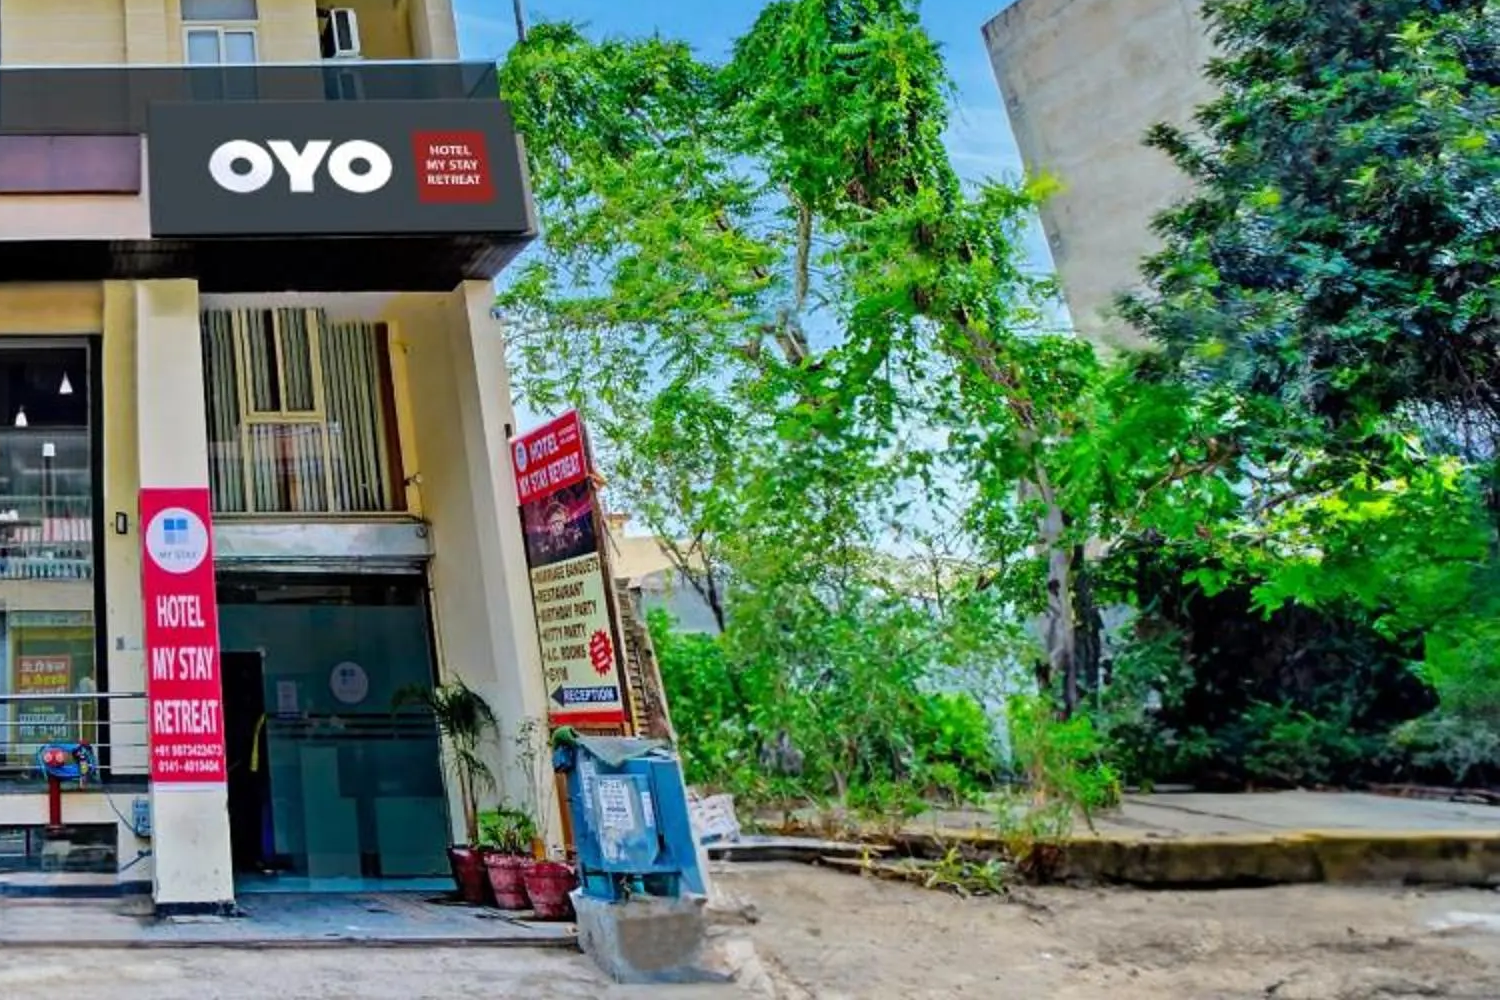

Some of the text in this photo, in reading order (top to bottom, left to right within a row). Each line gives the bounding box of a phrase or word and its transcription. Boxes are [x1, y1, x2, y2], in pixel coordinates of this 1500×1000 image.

[429, 144, 472, 156] HOTEL
[208, 139, 392, 193] OYO
[426, 160, 478, 171] MY STAY
[427, 174, 481, 185] RETREAT
[529, 432, 559, 463] HOTEL
[547, 451, 581, 485] RETREAT
[156, 595, 205, 628] HOTEL
[573, 599, 597, 617] PARTY
[564, 621, 587, 638] PARTY
[153, 647, 213, 680] MY STAY
[563, 687, 615, 704] RECEPTION
[153, 700, 219, 735] RETREAT
